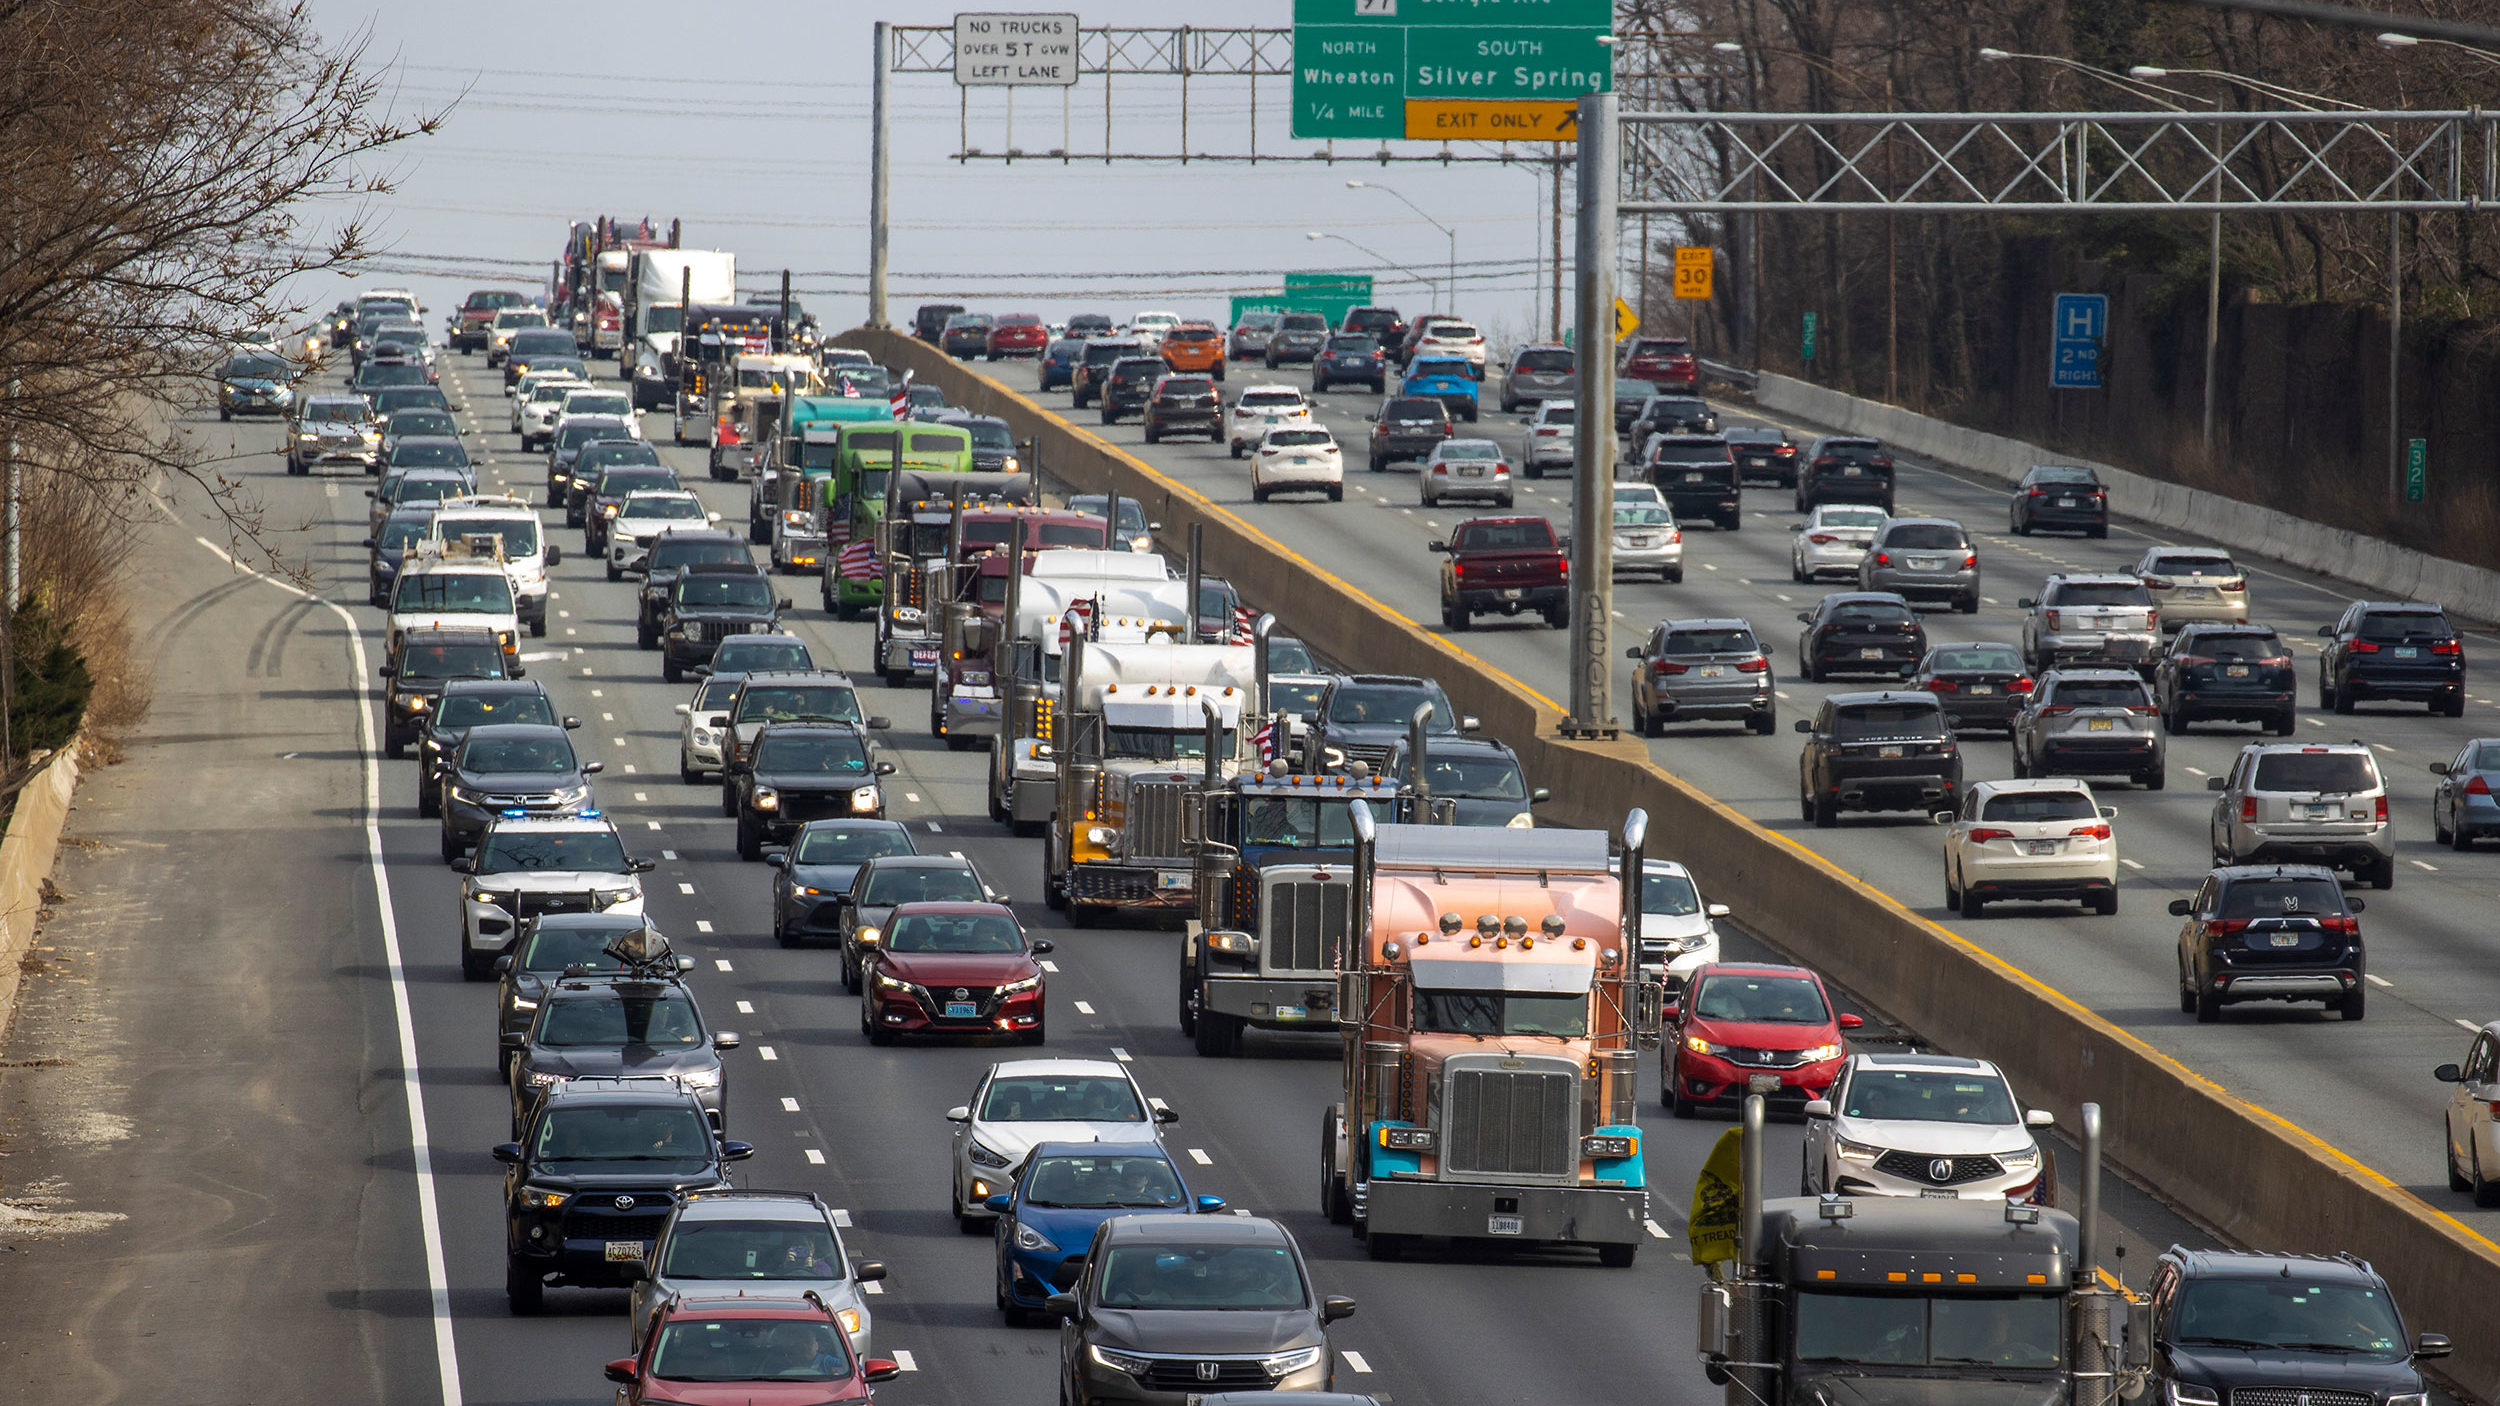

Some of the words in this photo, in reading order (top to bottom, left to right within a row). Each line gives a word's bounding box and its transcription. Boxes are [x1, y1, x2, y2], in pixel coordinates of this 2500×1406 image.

[969, 22, 991, 33] NO
[1001, 21, 1062, 34] TRUCKS
[964, 44, 999, 55] OVER
[1006, 42, 1017, 57] 5
[1023, 42, 1034, 56] T
[1041, 45, 1069, 55] GVW
[1322, 41, 1376, 54] NORTH
[1478, 40, 1542, 56] SOUTH
[972, 66, 1009, 77] LEFT
[1018, 66, 1060, 77] LANE
[1304, 68, 1394, 84] Wheaton
[1419, 65, 1498, 86] Silver
[1514, 66, 1602, 92] Spring
[1349, 105, 1384, 118] MILE
[1436, 113, 1478, 127] EXIT
[1490, 113, 1542, 128] ONLY
[1681, 252, 1705, 260] EXIT
[1680, 268, 1706, 284] 30
[2068, 308, 2092, 335] H
[1701, 1229, 1736, 1245] TREAD
